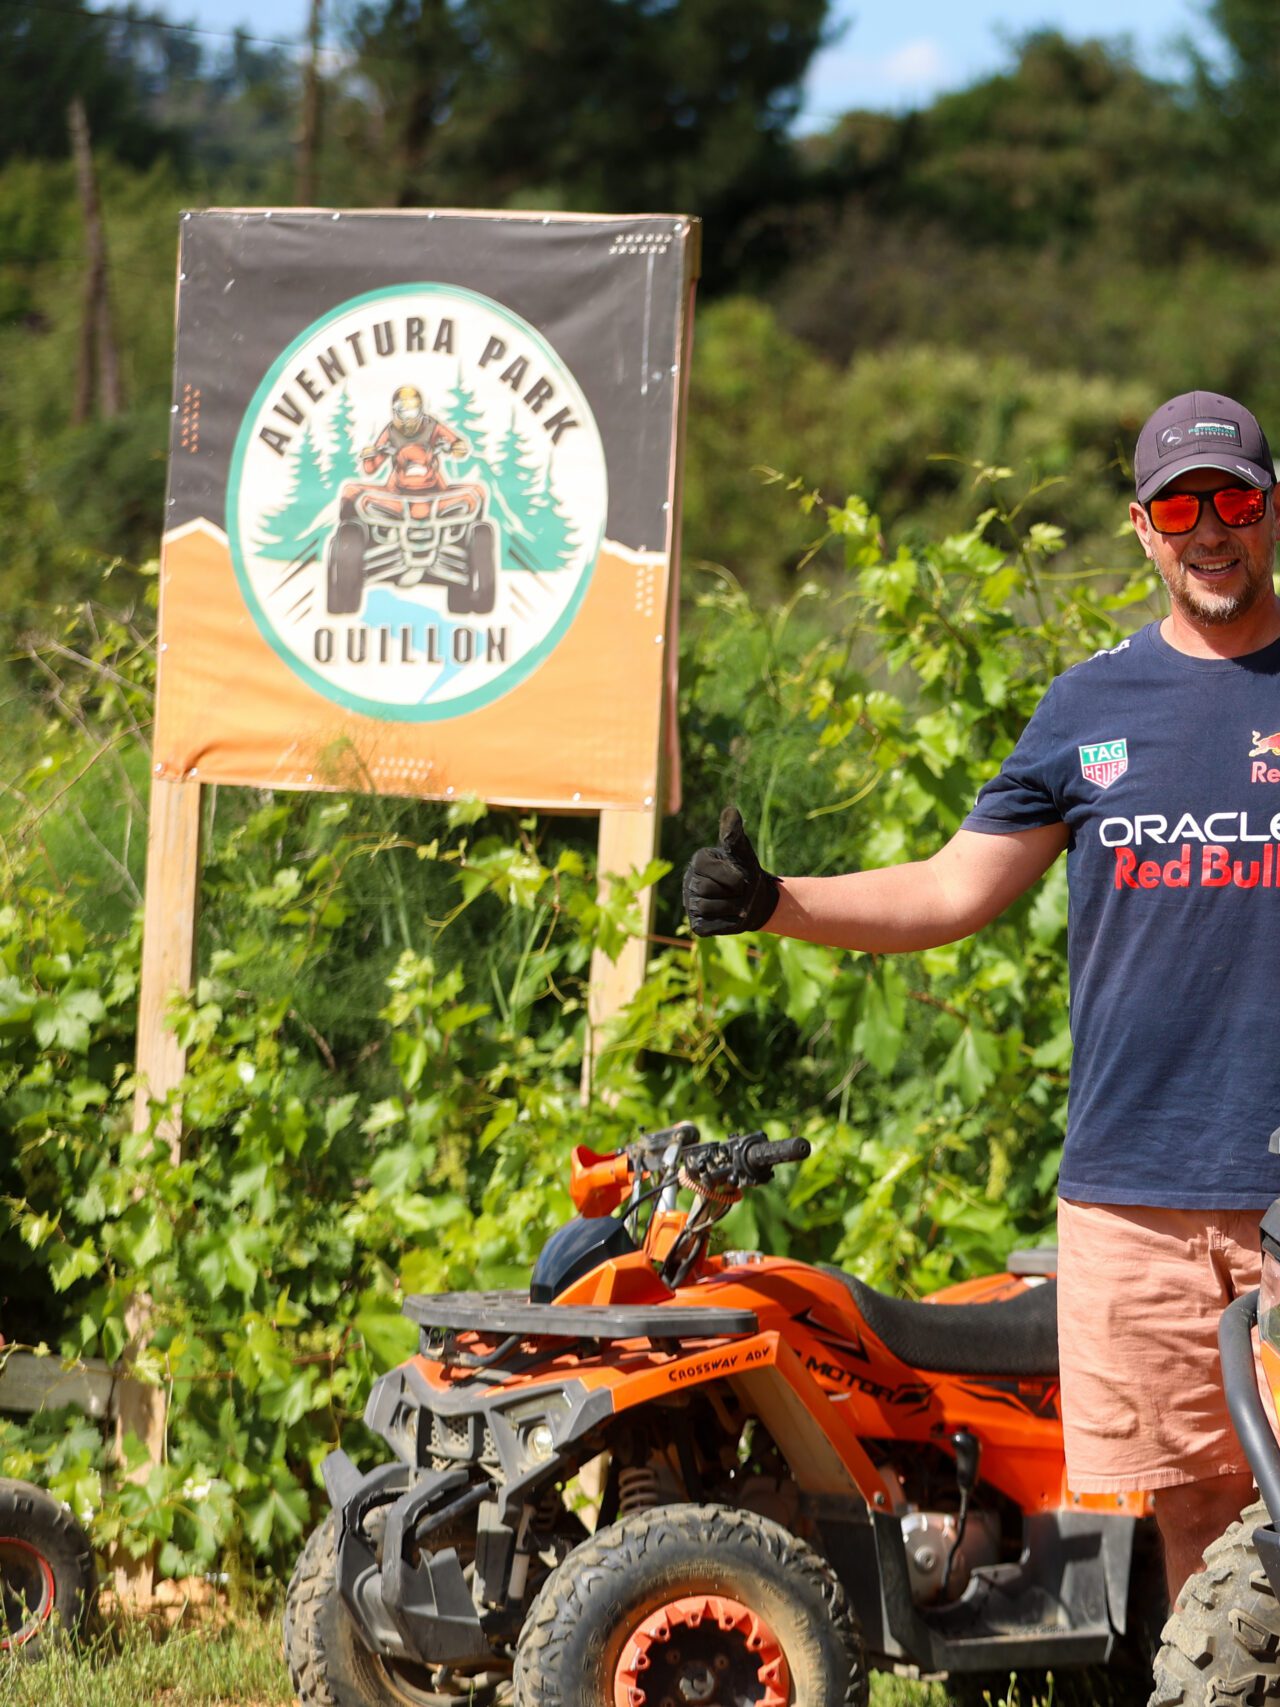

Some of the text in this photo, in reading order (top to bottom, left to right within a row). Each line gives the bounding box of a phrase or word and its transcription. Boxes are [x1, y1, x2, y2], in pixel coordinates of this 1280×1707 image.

[258, 316, 579, 457] AVENTURA PARK
[1084, 743, 1124, 762] TAG
[1084, 760, 1126, 785] HEUER
[1114, 843, 1192, 890] Red
